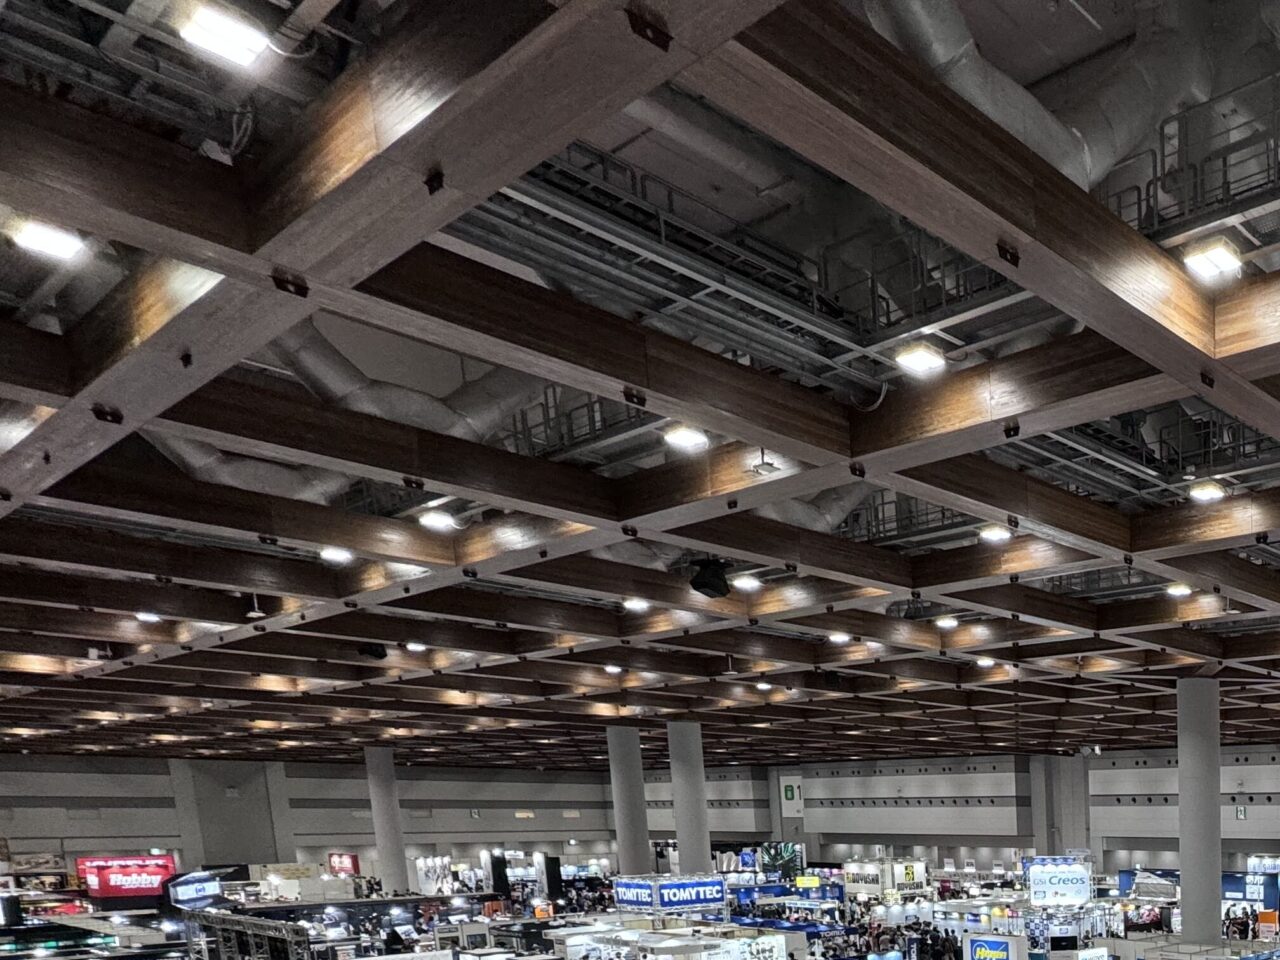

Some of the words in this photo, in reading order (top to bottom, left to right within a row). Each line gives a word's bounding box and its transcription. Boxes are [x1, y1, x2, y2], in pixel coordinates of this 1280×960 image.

[109, 873, 162, 887] Hobby
[1049, 875, 1085, 885] Creos
[617, 886, 652, 901] TOMYTEC
[660, 886, 722, 902] TOMYTEC
